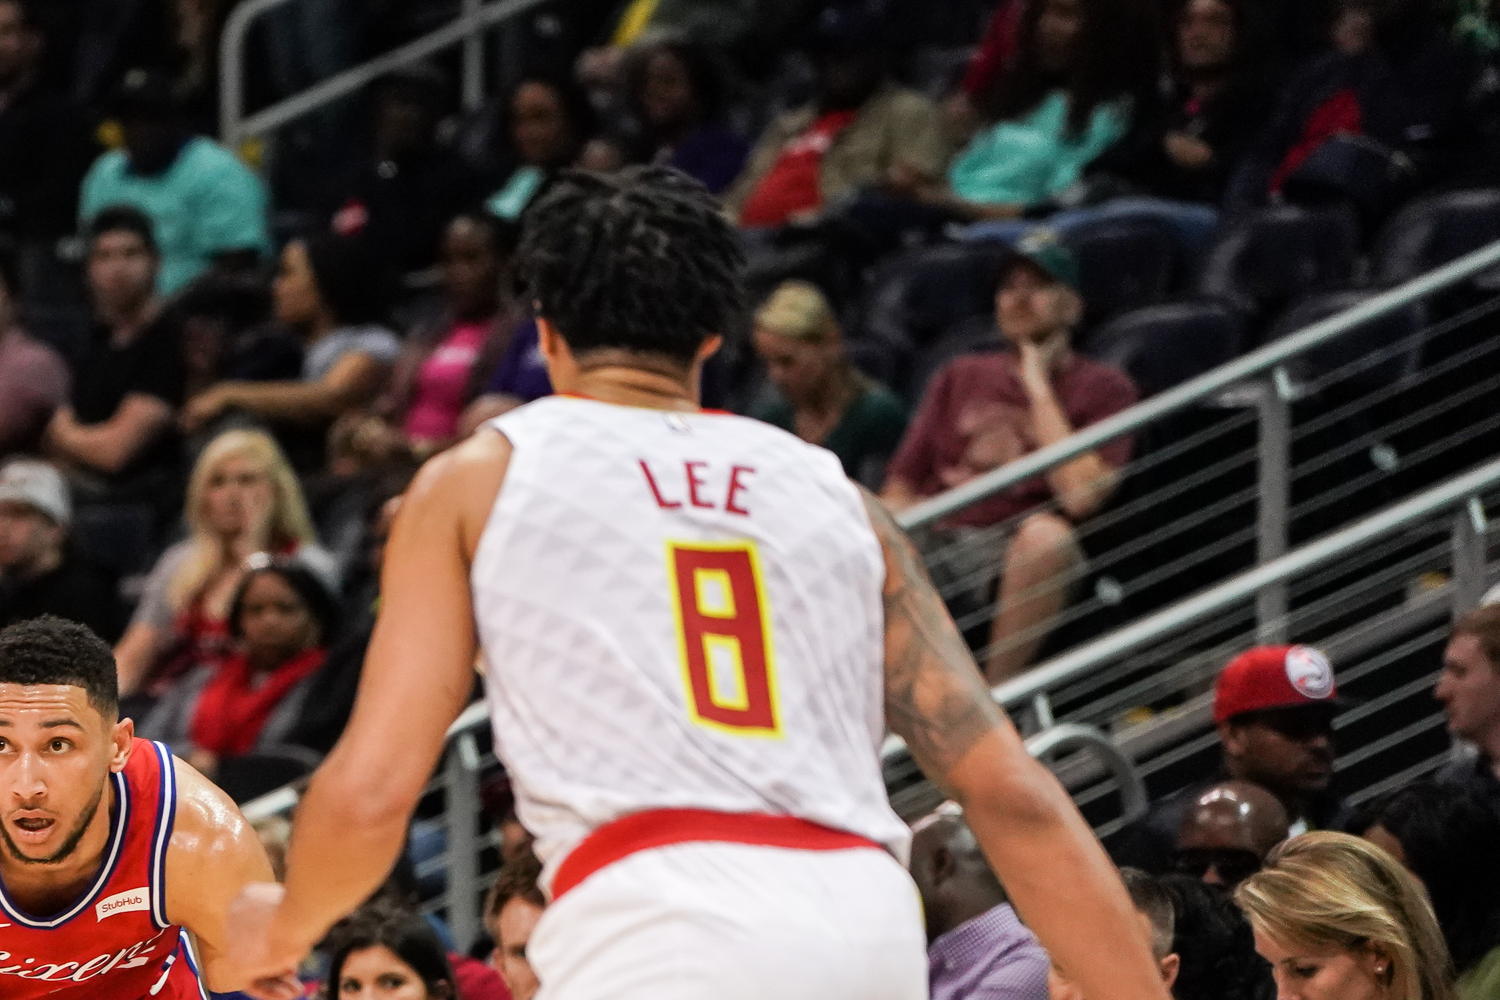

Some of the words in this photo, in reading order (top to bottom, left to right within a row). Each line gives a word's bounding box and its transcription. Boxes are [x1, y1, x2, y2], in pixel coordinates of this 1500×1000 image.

[638, 458, 756, 516] LEE
[664, 537, 785, 741] 8
[101, 896, 143, 913] StubHub
